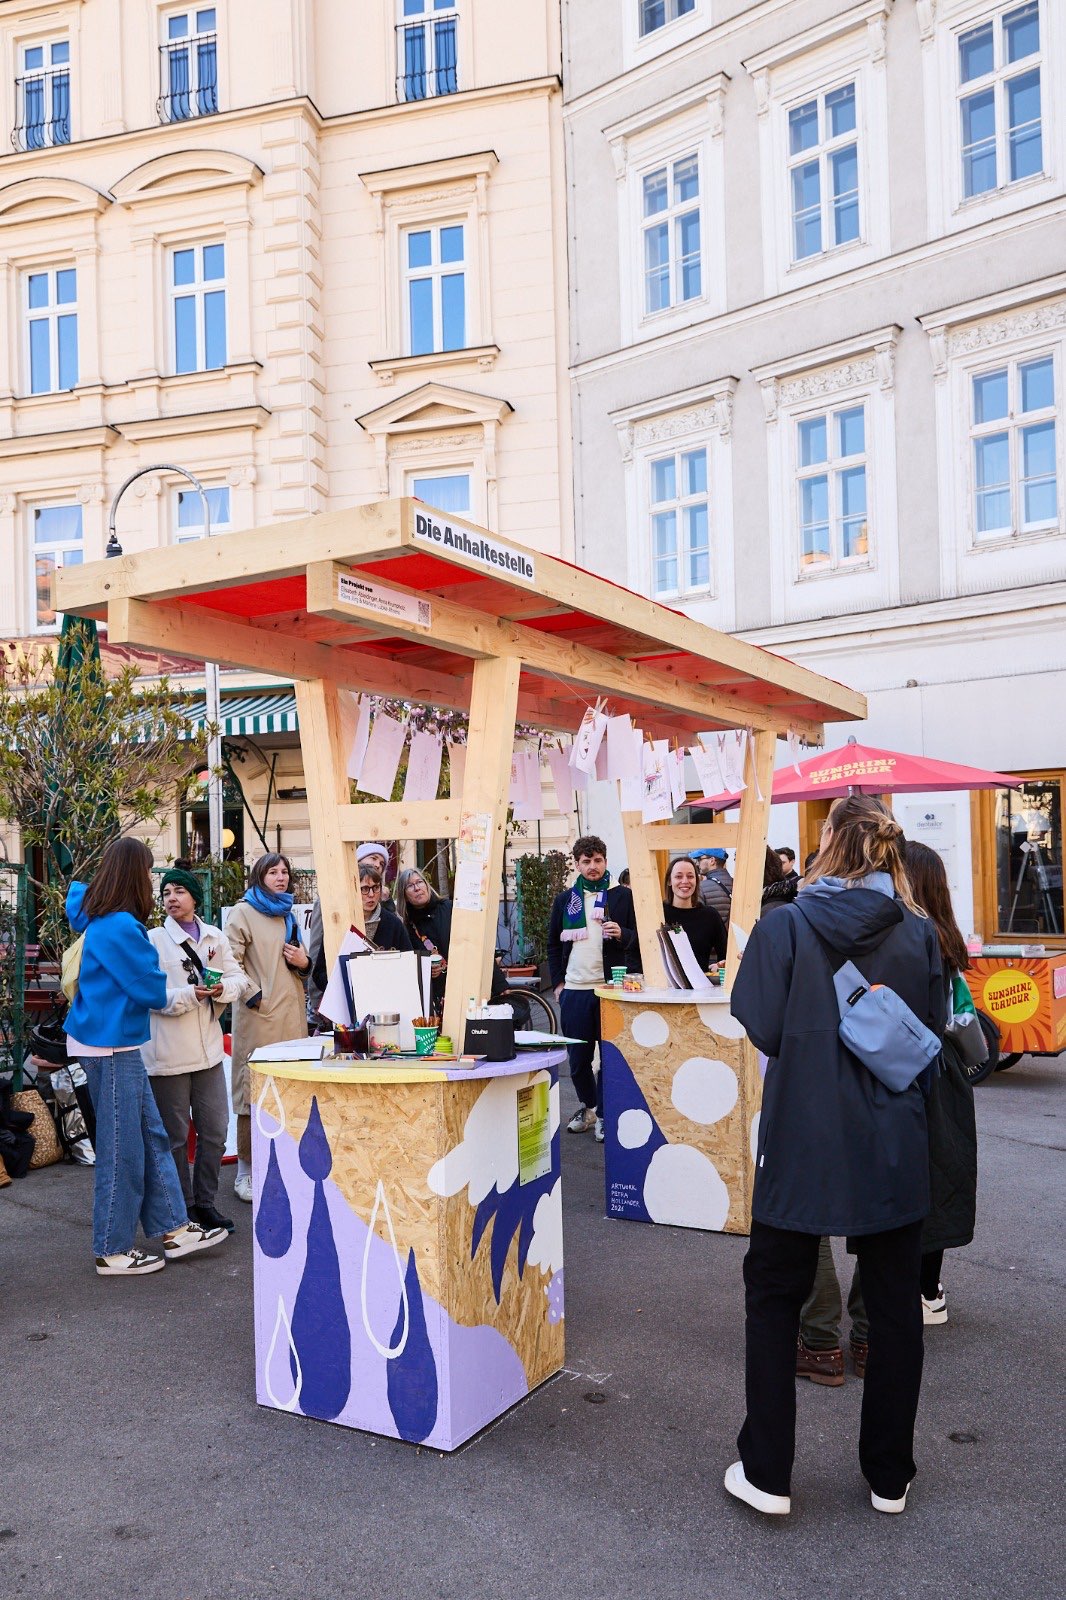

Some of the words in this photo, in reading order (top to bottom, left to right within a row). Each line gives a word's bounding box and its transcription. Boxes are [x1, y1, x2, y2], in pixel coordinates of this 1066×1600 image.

[416, 514, 441, 542] Die
[444, 526, 533, 578] Anhaltestelle
[349, 580, 365, 590] Projekt
[809, 759, 896, 778] SUNSHINE
[812, 765, 892, 784] FLAVOUR
[988, 982, 1032, 1000] SUNSHINE
[991, 992, 1030, 1011] FLAVOUR
[611, 1191, 629, 1199] PETRA
